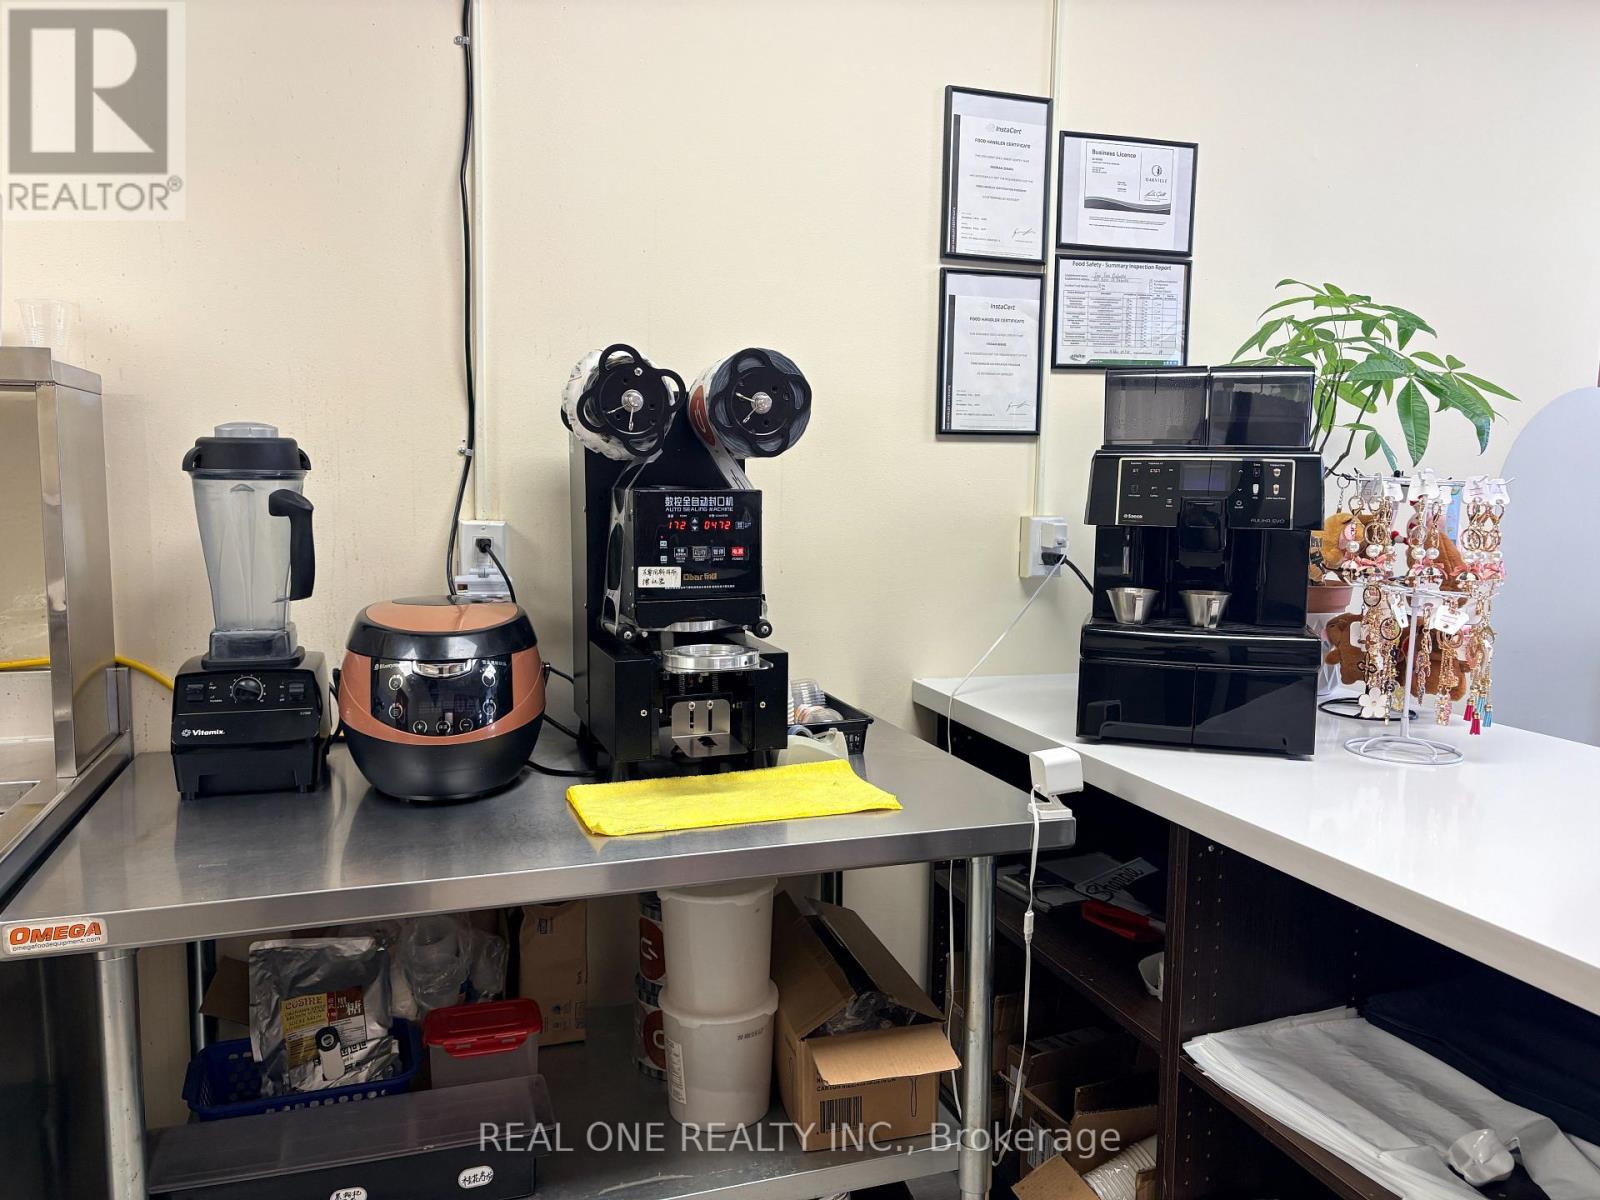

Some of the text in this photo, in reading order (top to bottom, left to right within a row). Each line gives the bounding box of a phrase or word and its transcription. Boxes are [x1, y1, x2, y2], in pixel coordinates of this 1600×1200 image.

[995, 125, 1022, 135] InstaCert
[1092, 149, 1137, 159] Business Licence
[1086, 261, 1102, 269] Safety
[1105, 262, 1128, 270] Summary
[1129, 263, 1154, 271] Inspection
[990, 303, 1016, 311] InstaCert
[665, 496, 734, 507] 数控全自动封口机
[668, 520, 687, 530] 172
[704, 520, 731, 530] 0472
[192, 729, 225, 737] Vitamix
[9, 921, 102, 946] OMEGA
